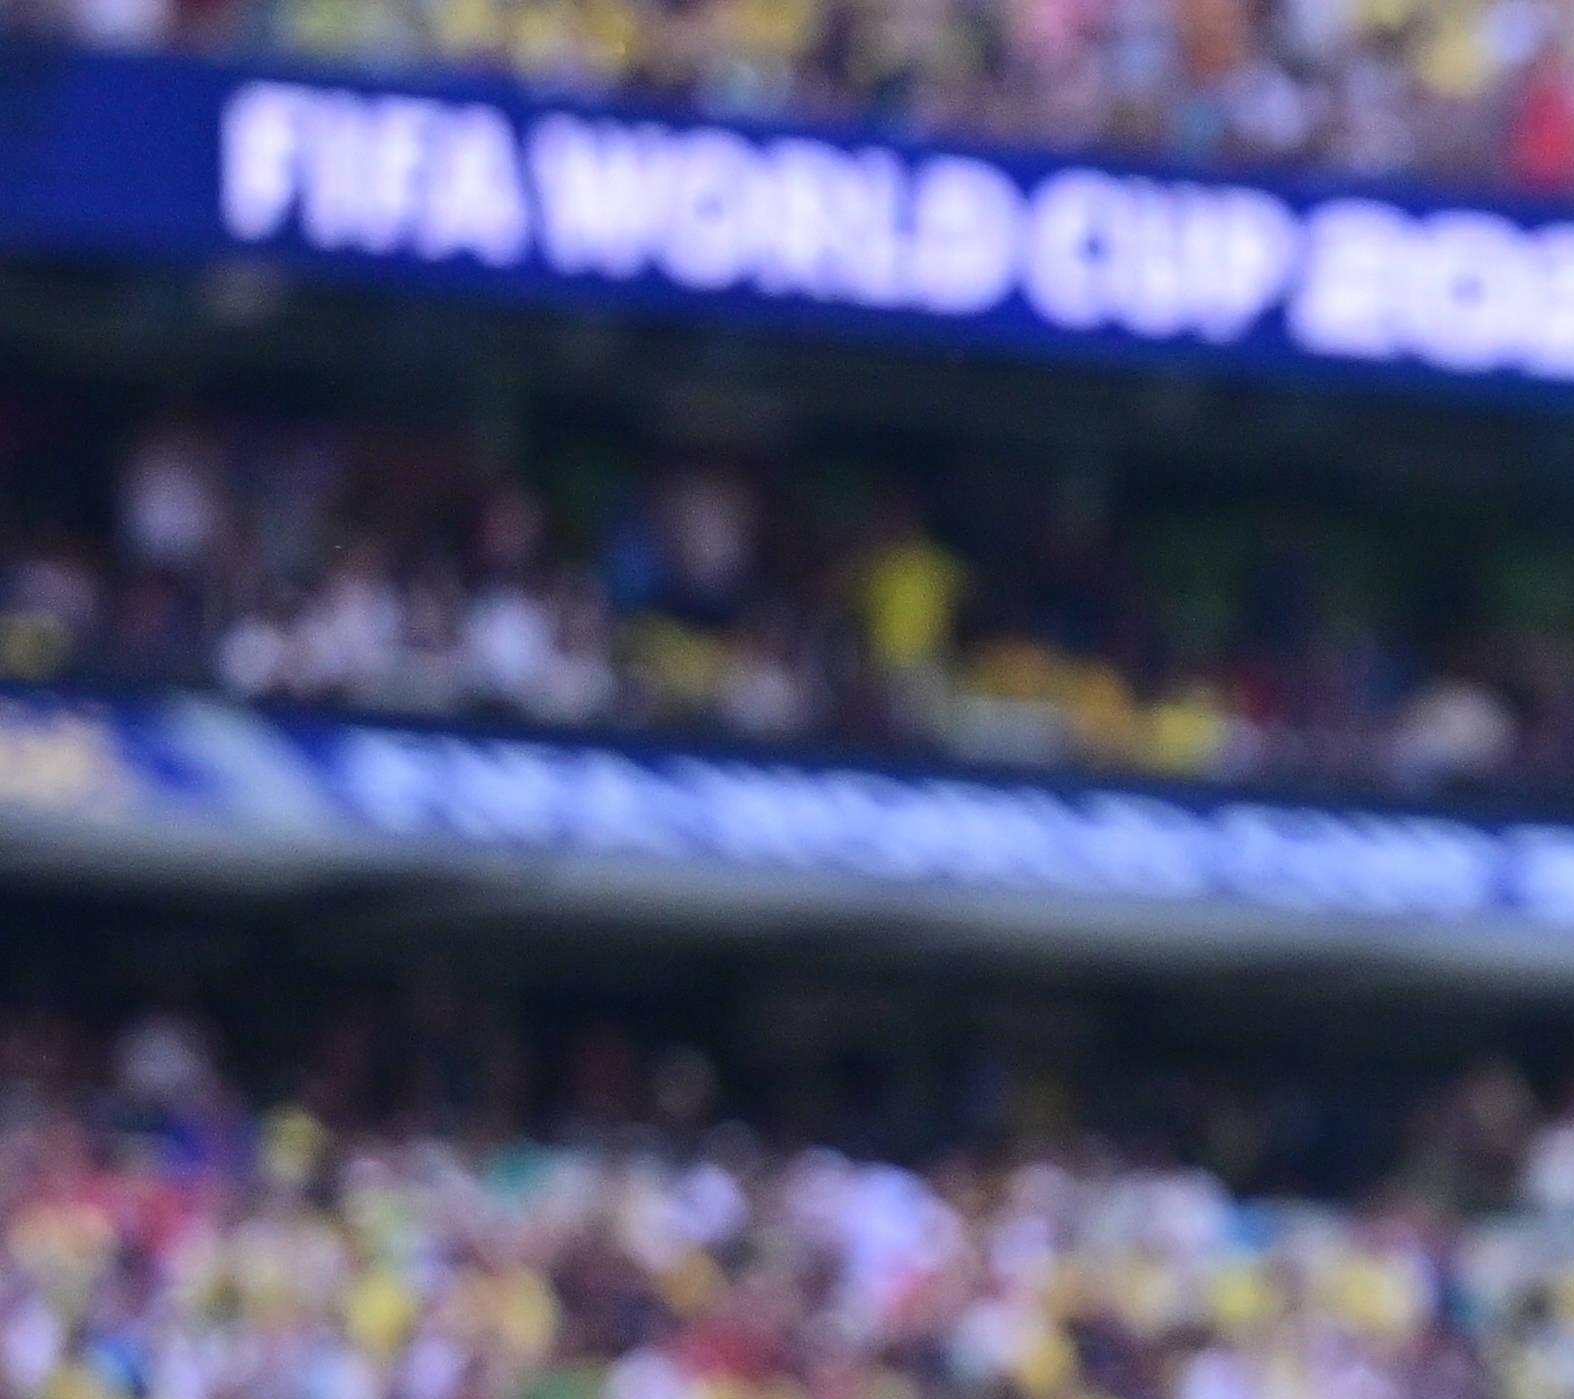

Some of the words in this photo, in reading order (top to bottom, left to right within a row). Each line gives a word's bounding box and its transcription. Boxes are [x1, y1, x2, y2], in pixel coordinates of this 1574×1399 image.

[222, 79, 532, 268] FIFA
[528, 110, 1022, 317] WORLD
[1021, 165, 1297, 344] CUP
